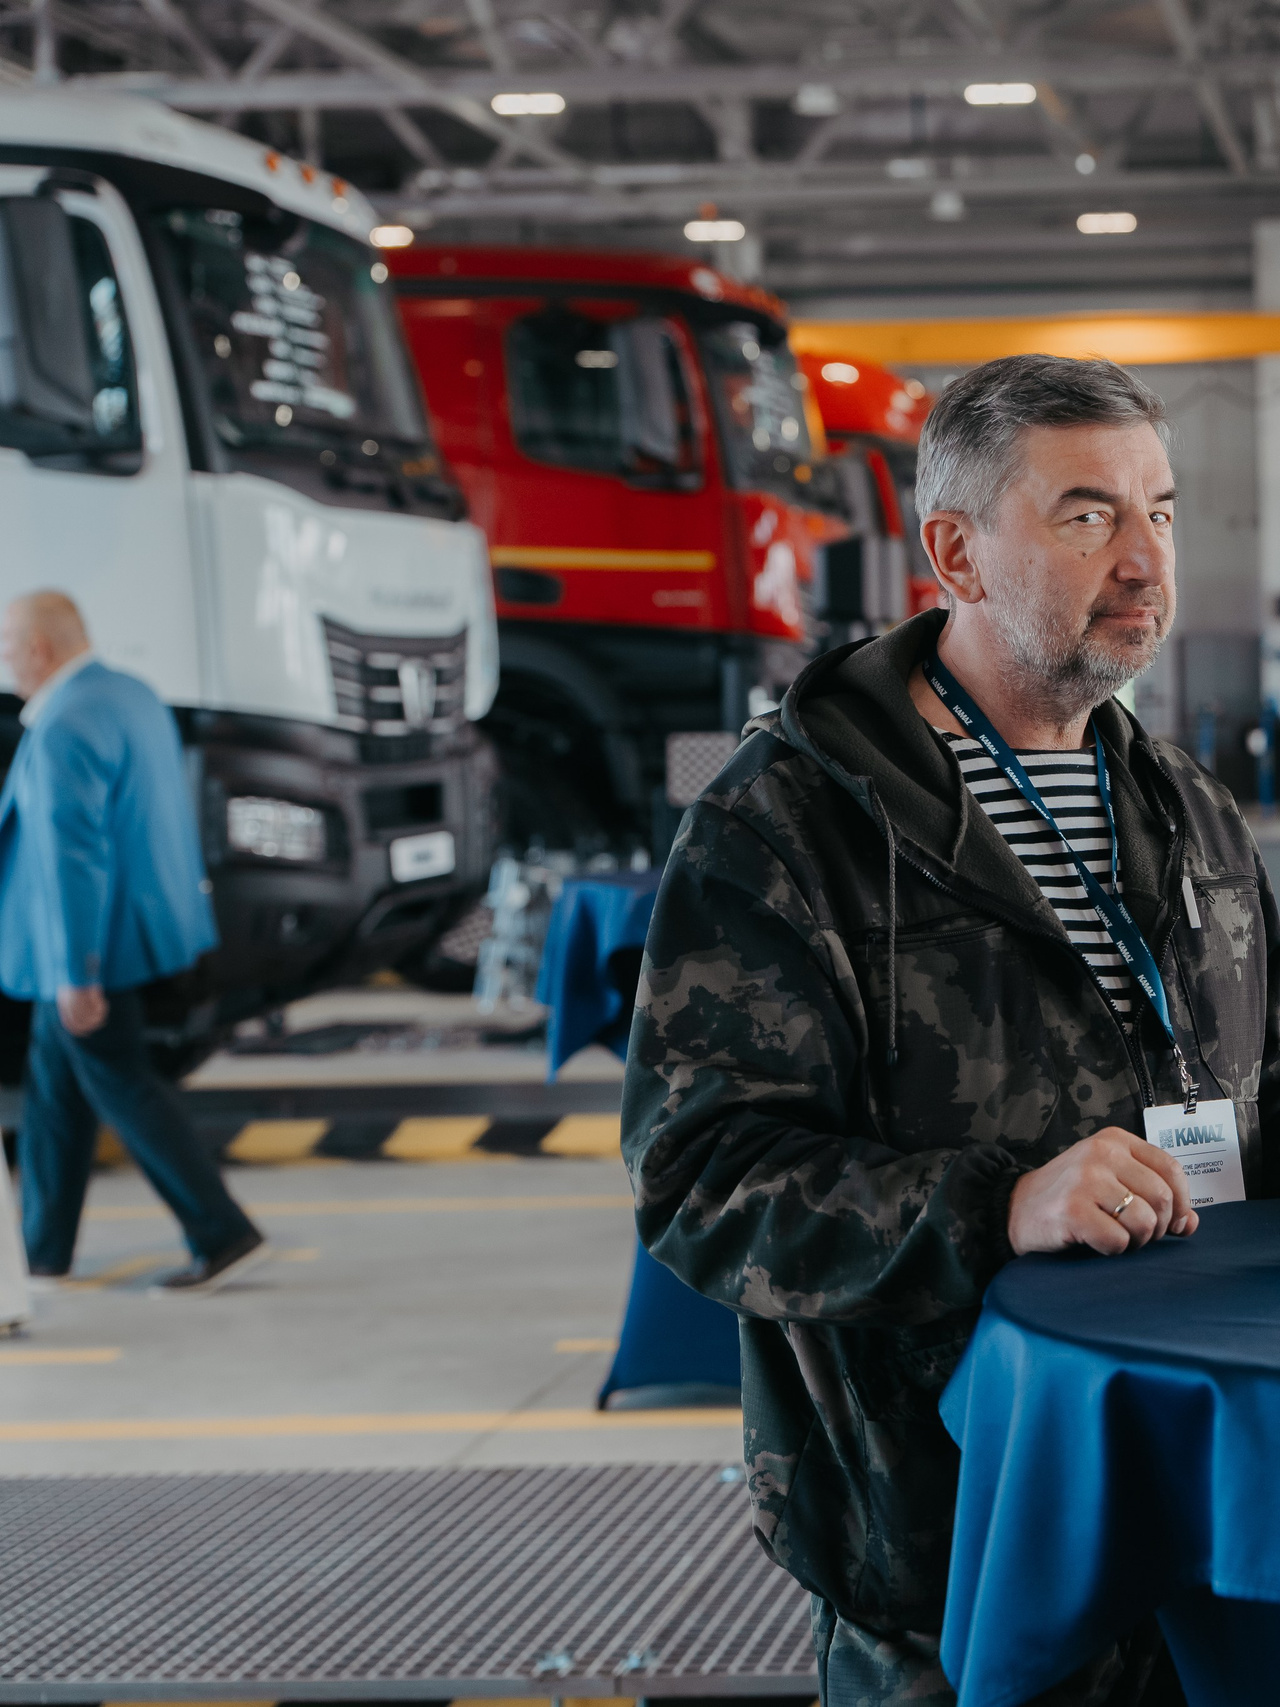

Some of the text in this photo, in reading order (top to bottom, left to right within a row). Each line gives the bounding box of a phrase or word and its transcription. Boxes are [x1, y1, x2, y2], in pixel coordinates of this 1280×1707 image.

[930, 676, 948, 697] KAMAZ
[952, 704, 973, 726] KAMAZ
[978, 734, 999, 756] KAMAZ
[1005, 766, 1024, 788] KAMAZ
[1094, 904, 1113, 929] KAMAZ
[1116, 940, 1134, 964] KAMAZ
[1137, 974, 1156, 999] KAMAZ
[1174, 1123, 1226, 1147] KAMAZ
[1189, 1196, 1214, 1206] трешко
